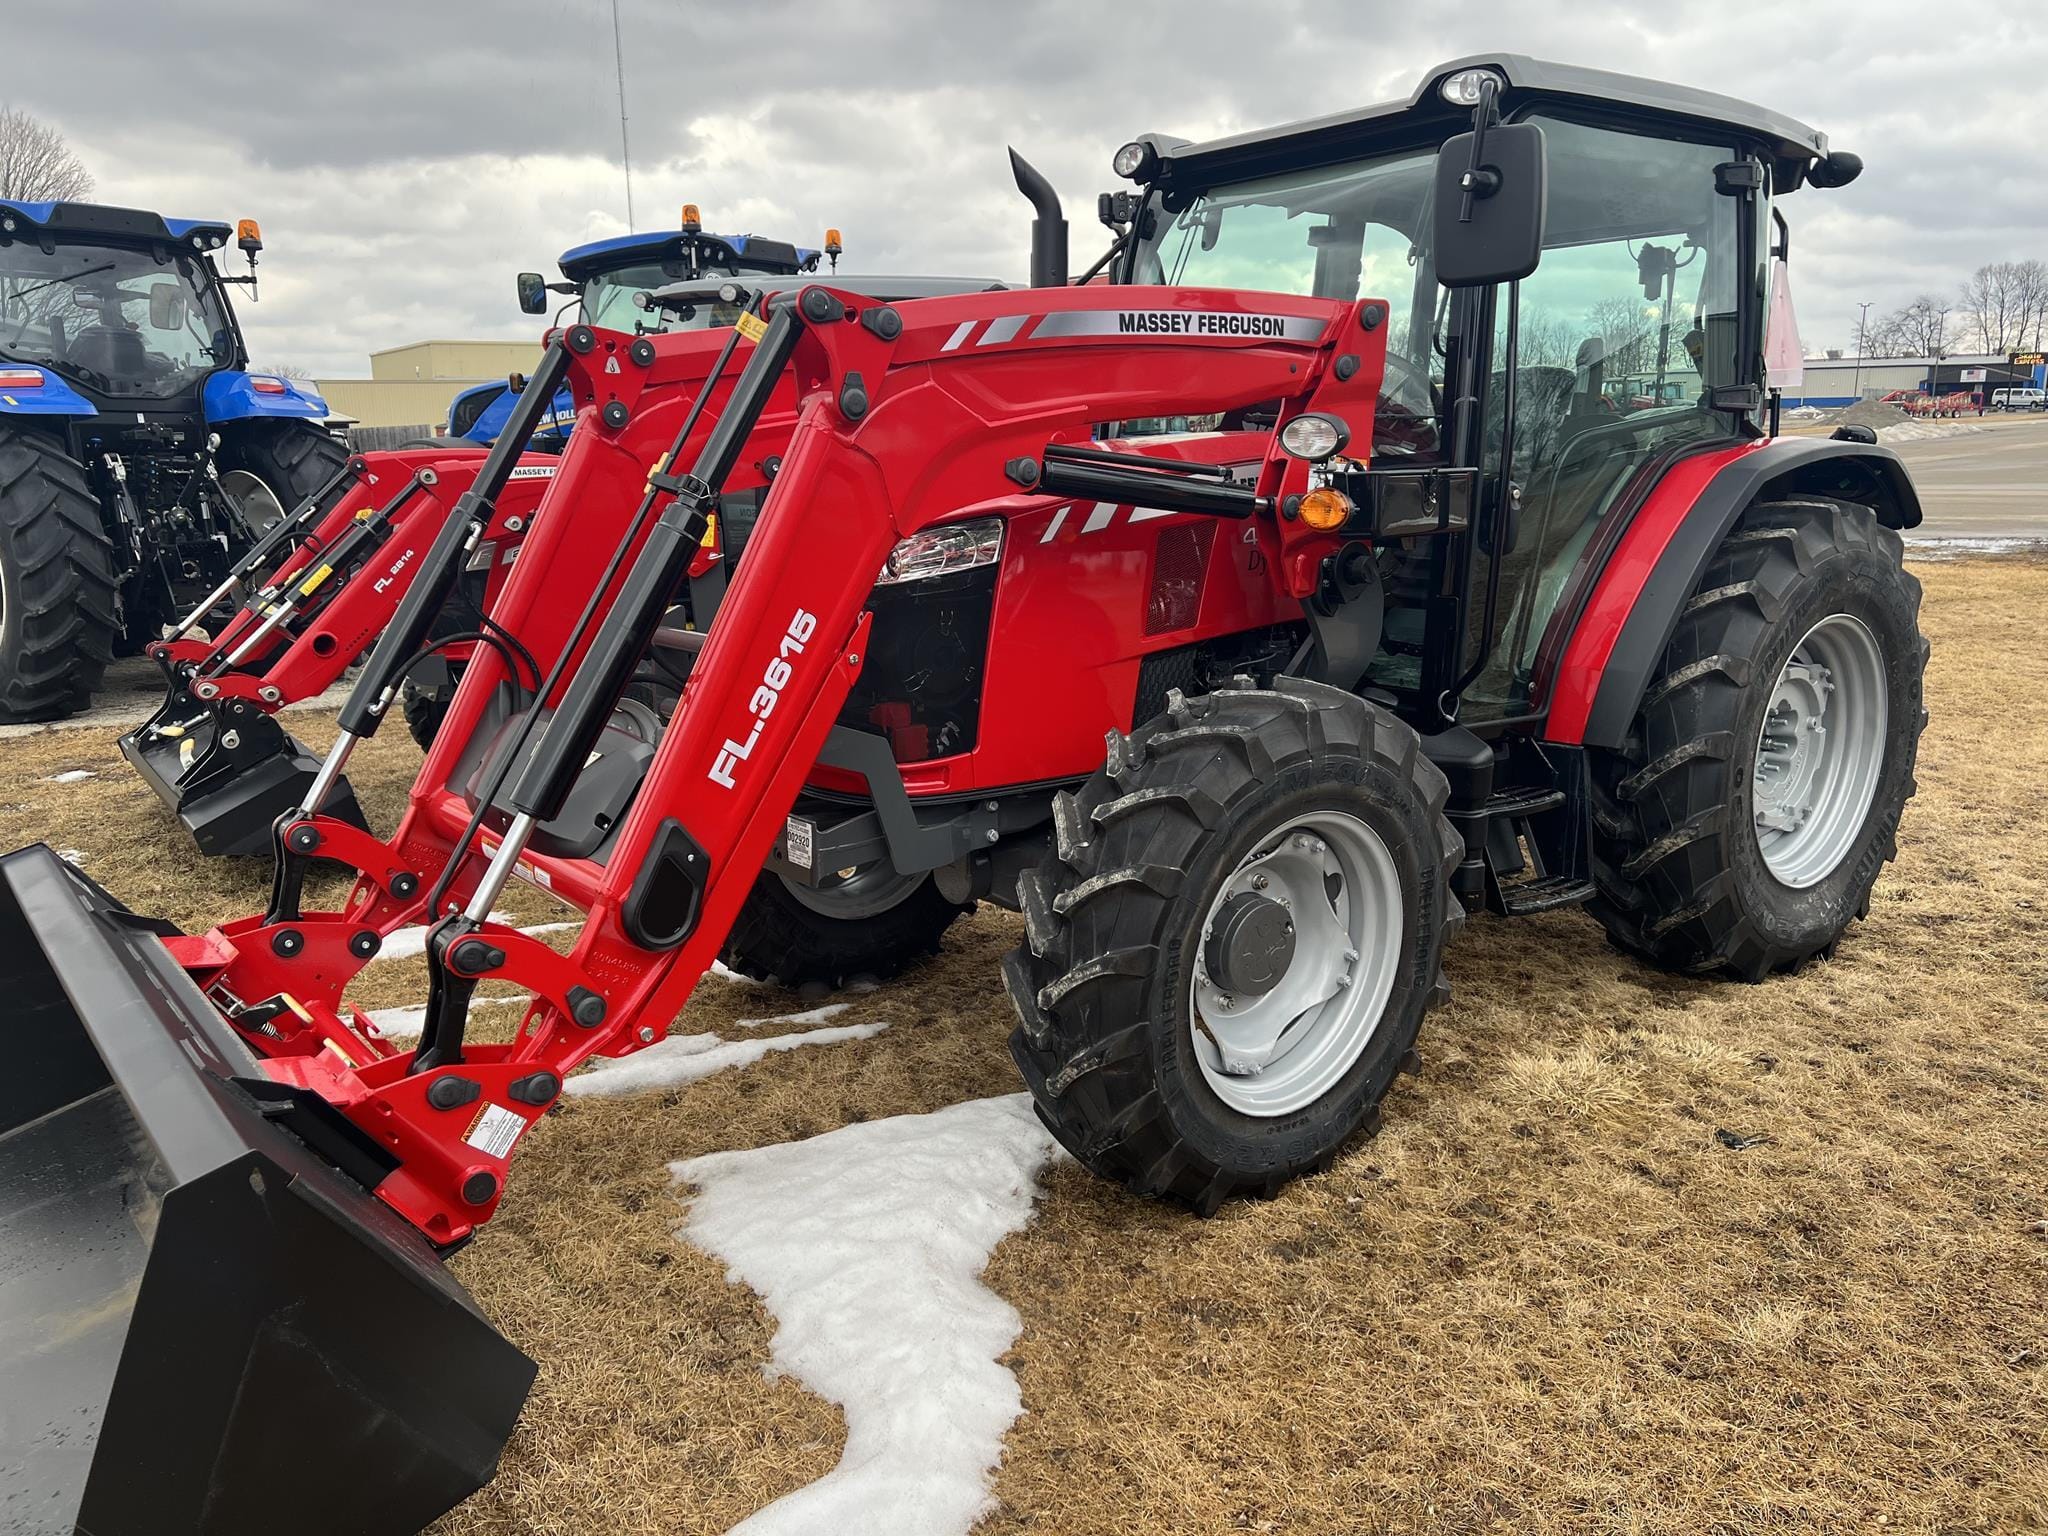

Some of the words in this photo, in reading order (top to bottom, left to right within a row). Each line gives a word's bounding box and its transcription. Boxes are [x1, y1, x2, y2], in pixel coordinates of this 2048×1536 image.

[1119, 313, 1192, 333] MASSEY
[1198, 315, 1285, 336] FERGUSON
[514, 468, 546, 477] MASSEY
[373, 577, 394, 594] FL
[390, 549, 414, 575] 2814
[707, 608, 817, 790] FL.3615
